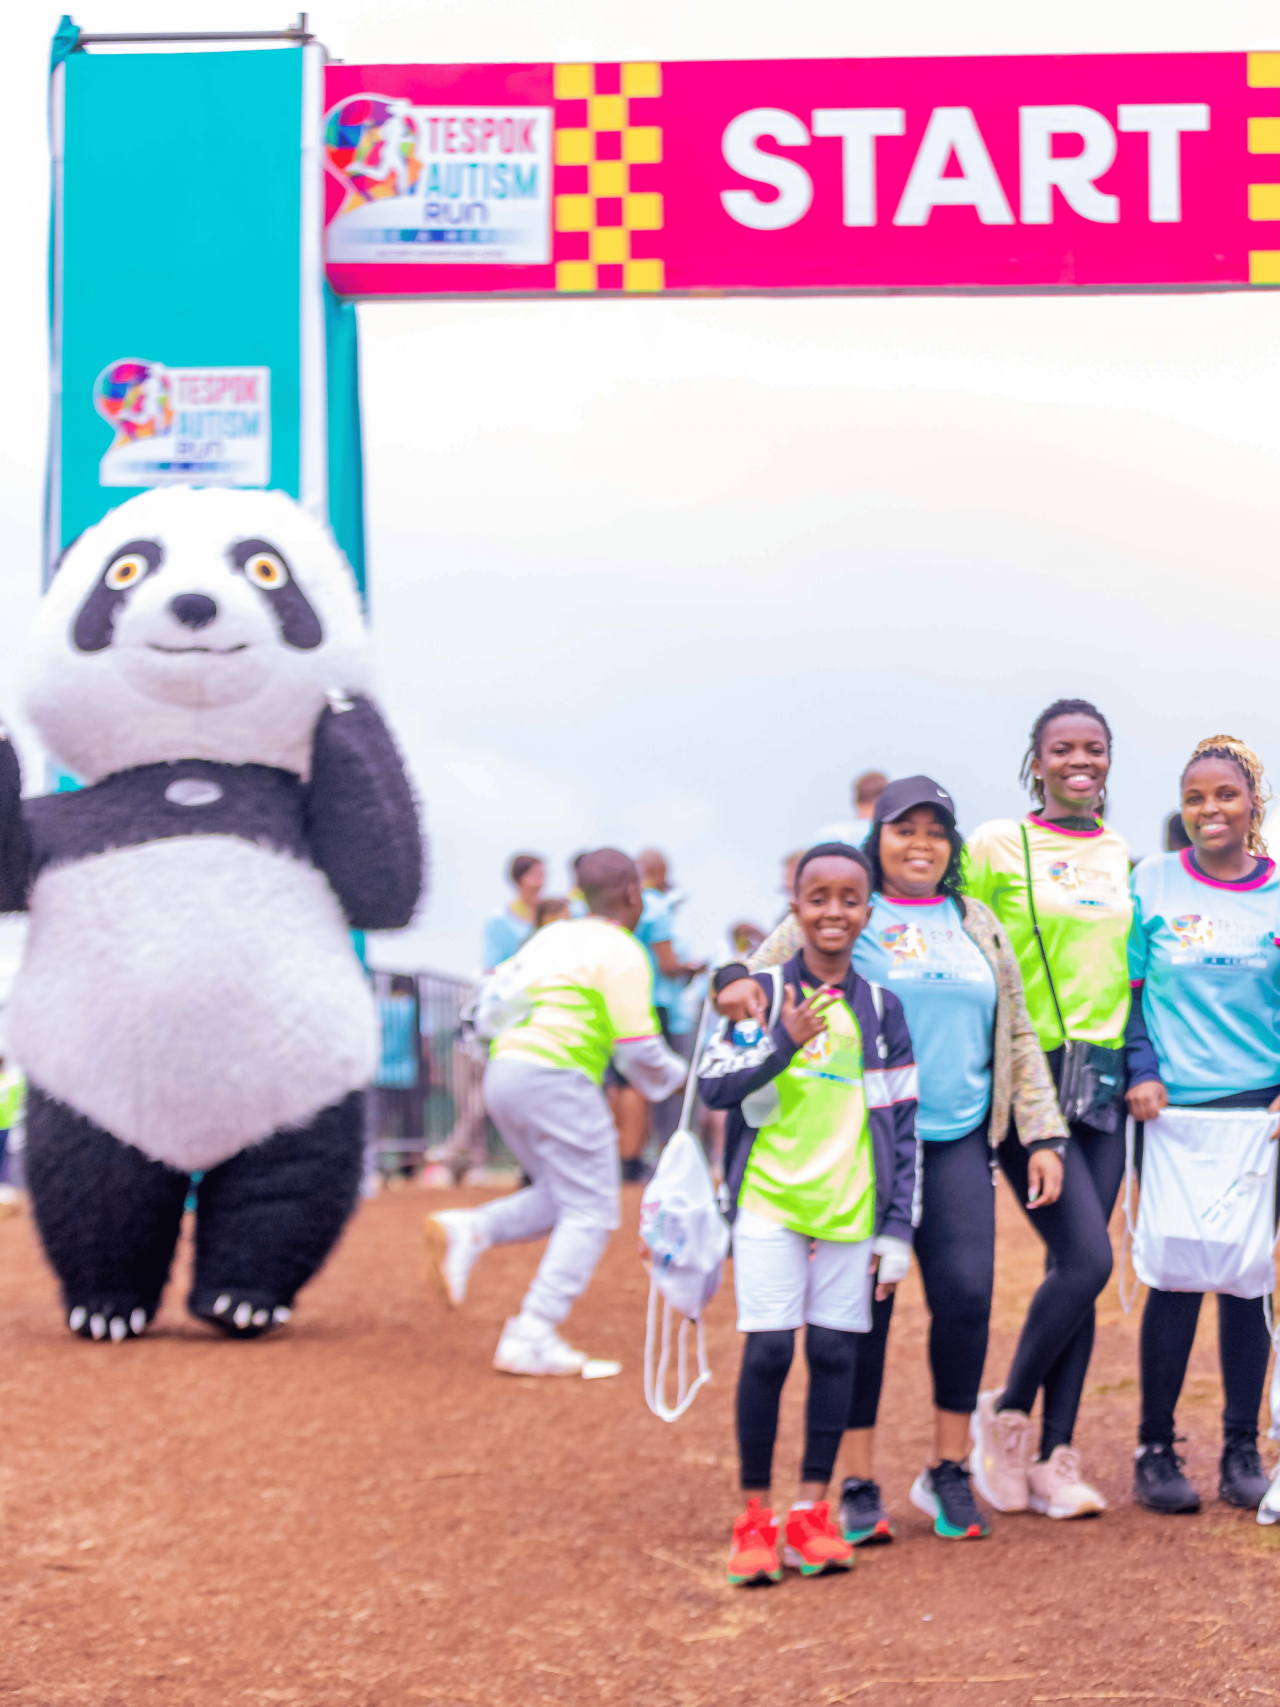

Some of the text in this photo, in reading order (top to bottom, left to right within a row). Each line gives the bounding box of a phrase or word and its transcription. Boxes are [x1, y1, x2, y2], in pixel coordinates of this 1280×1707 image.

[425, 117, 538, 154] TESPOK
[424, 162, 539, 199] AUTISM
[720, 103, 1210, 231] START
